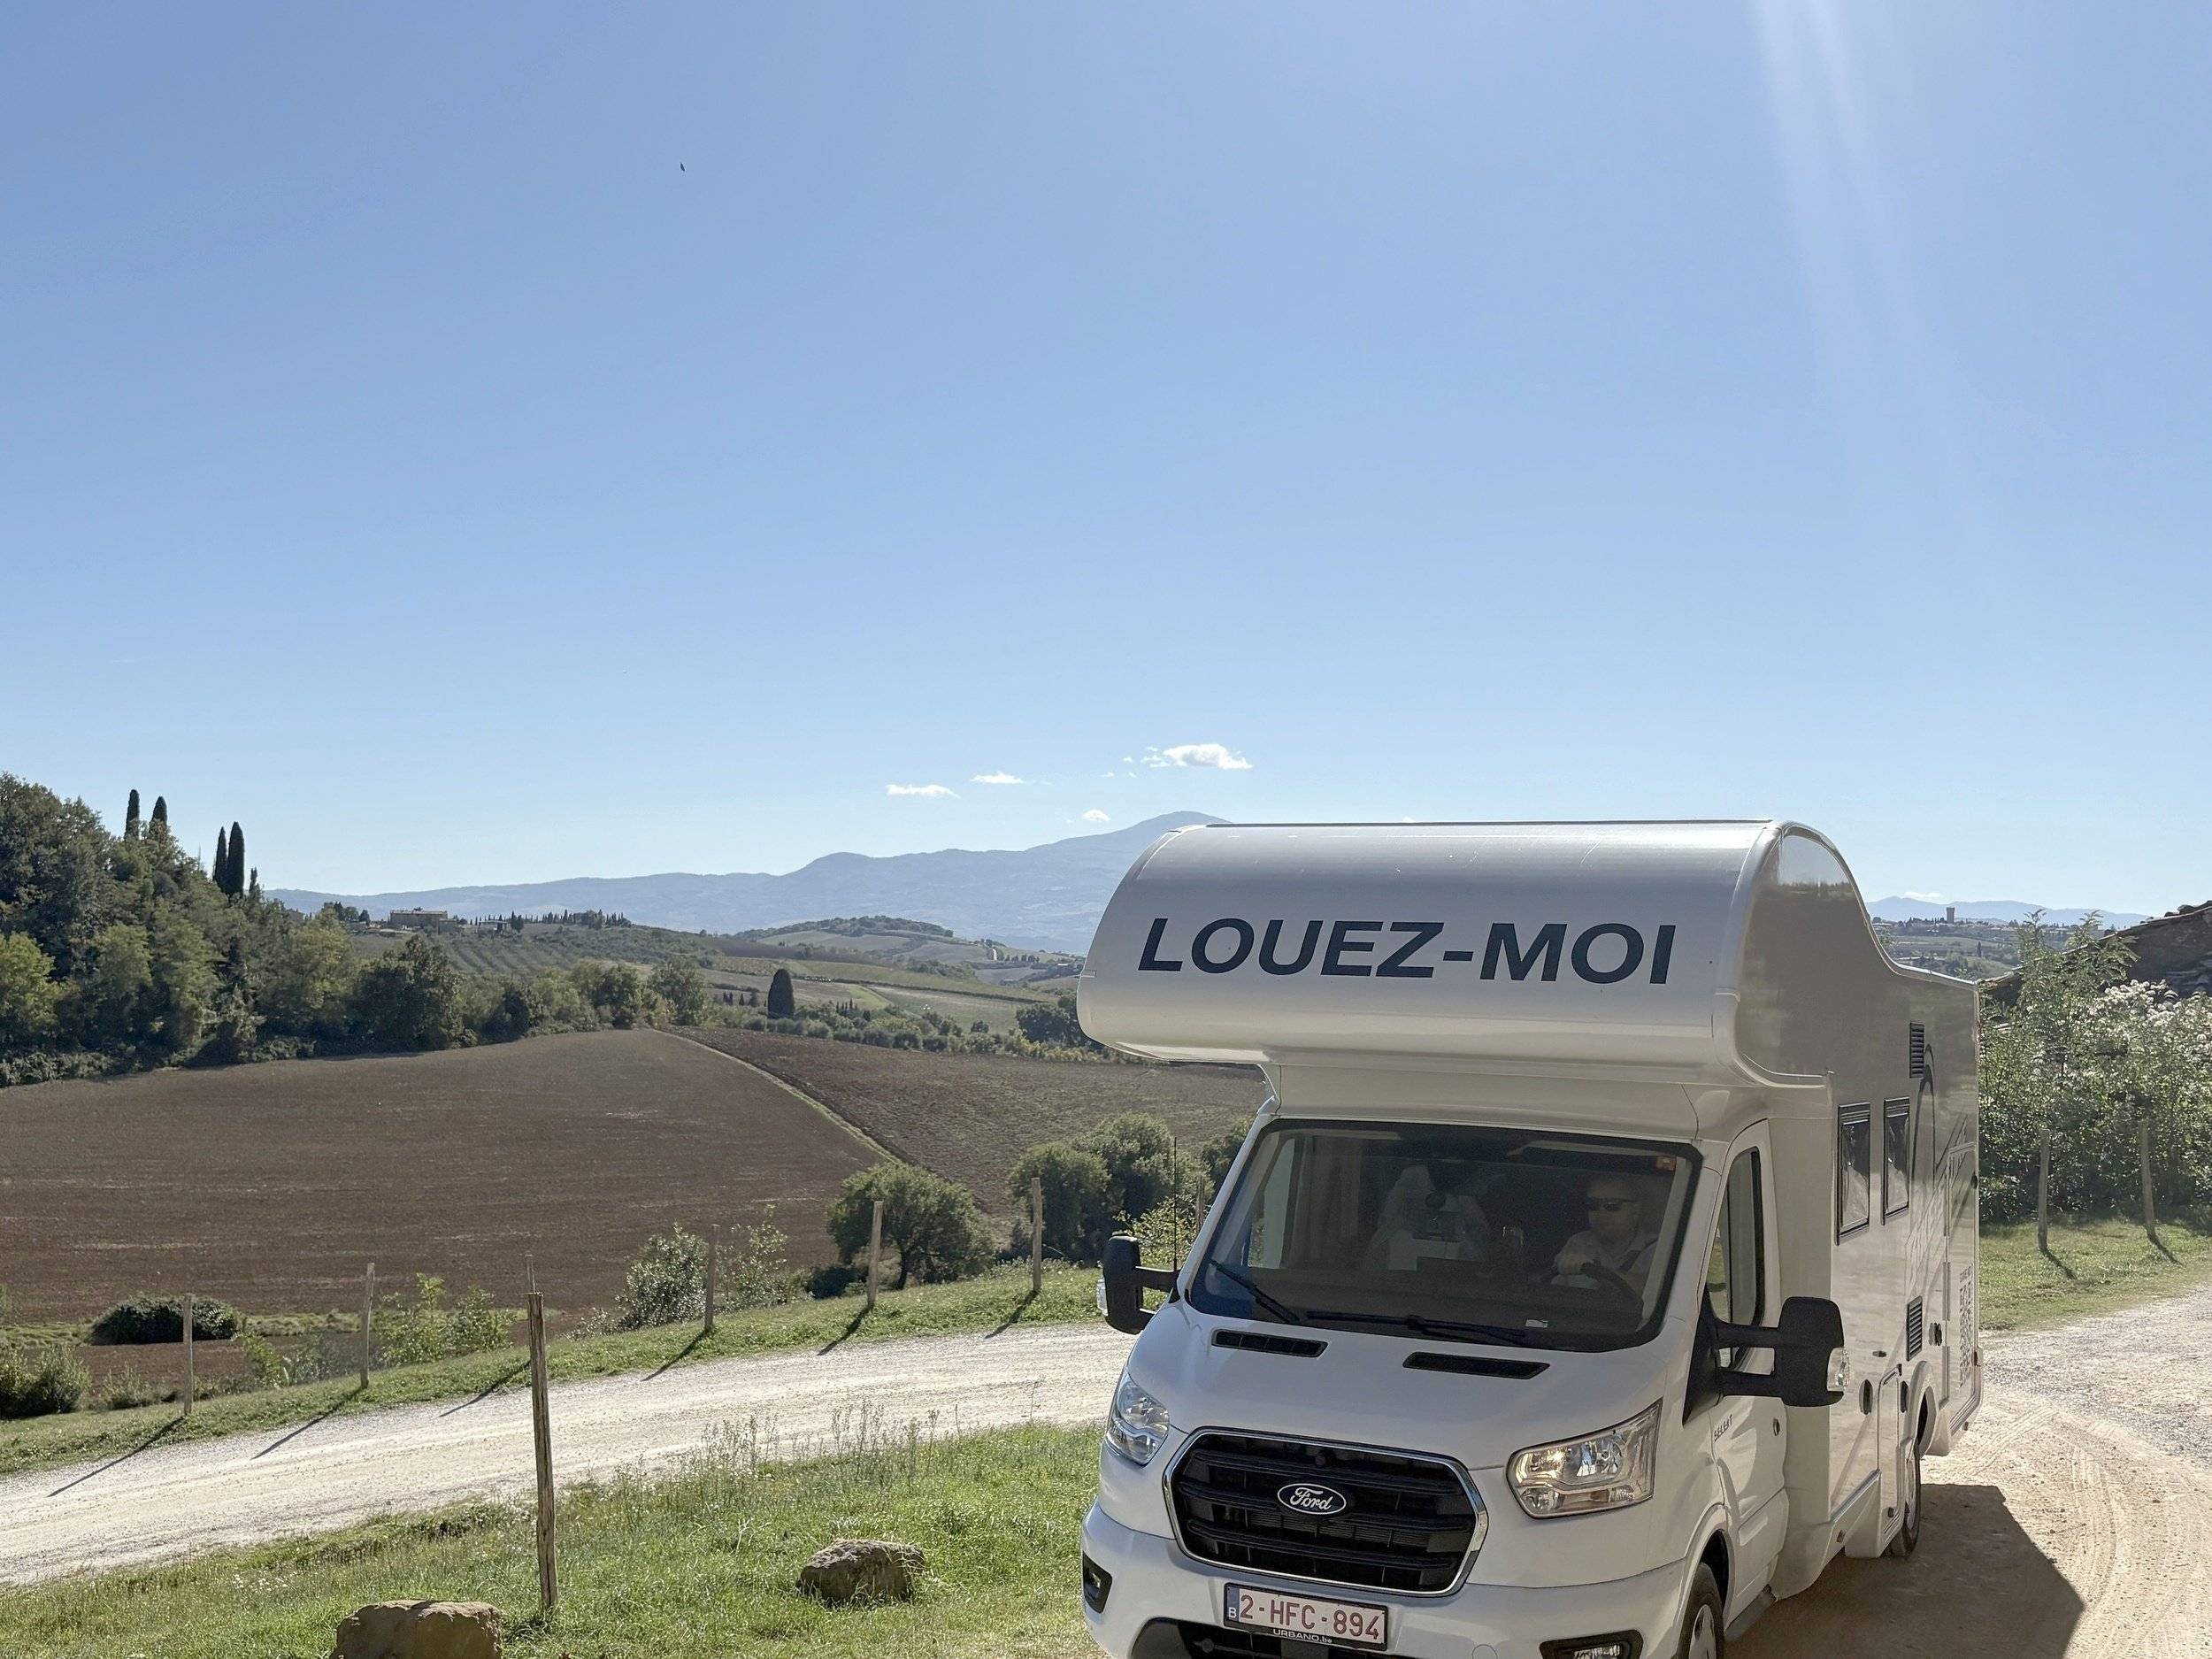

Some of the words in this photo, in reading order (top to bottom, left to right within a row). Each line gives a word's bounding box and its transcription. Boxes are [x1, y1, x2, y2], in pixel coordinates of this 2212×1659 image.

[1138, 918, 1677, 985] LOUEZ-MOI
[1290, 1487, 1333, 1510] Ford
[1228, 1607, 1237, 1618] B
[1240, 1594, 1379, 1640] 2-HFC-894
